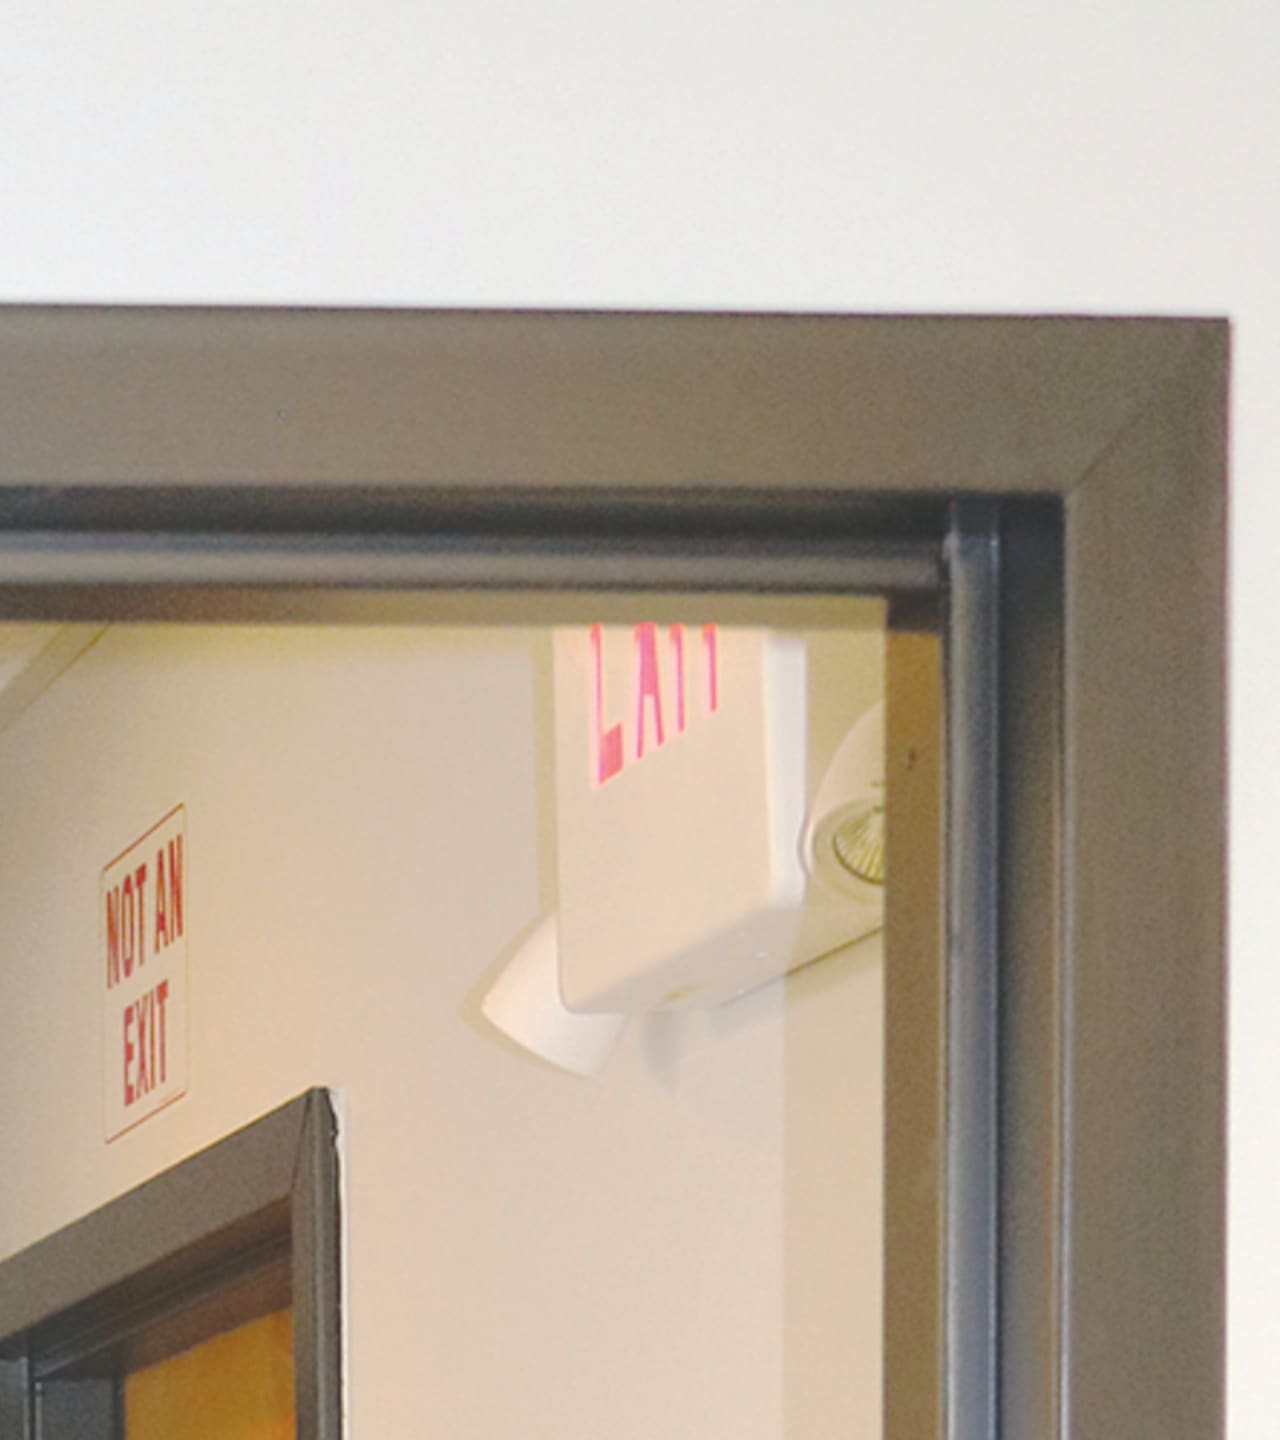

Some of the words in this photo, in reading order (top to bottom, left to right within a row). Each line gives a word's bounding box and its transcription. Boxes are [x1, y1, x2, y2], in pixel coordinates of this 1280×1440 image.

[106, 863, 147, 989] NOT
[154, 834, 183, 954] AN
[124, 979, 168, 1106] EXIT
